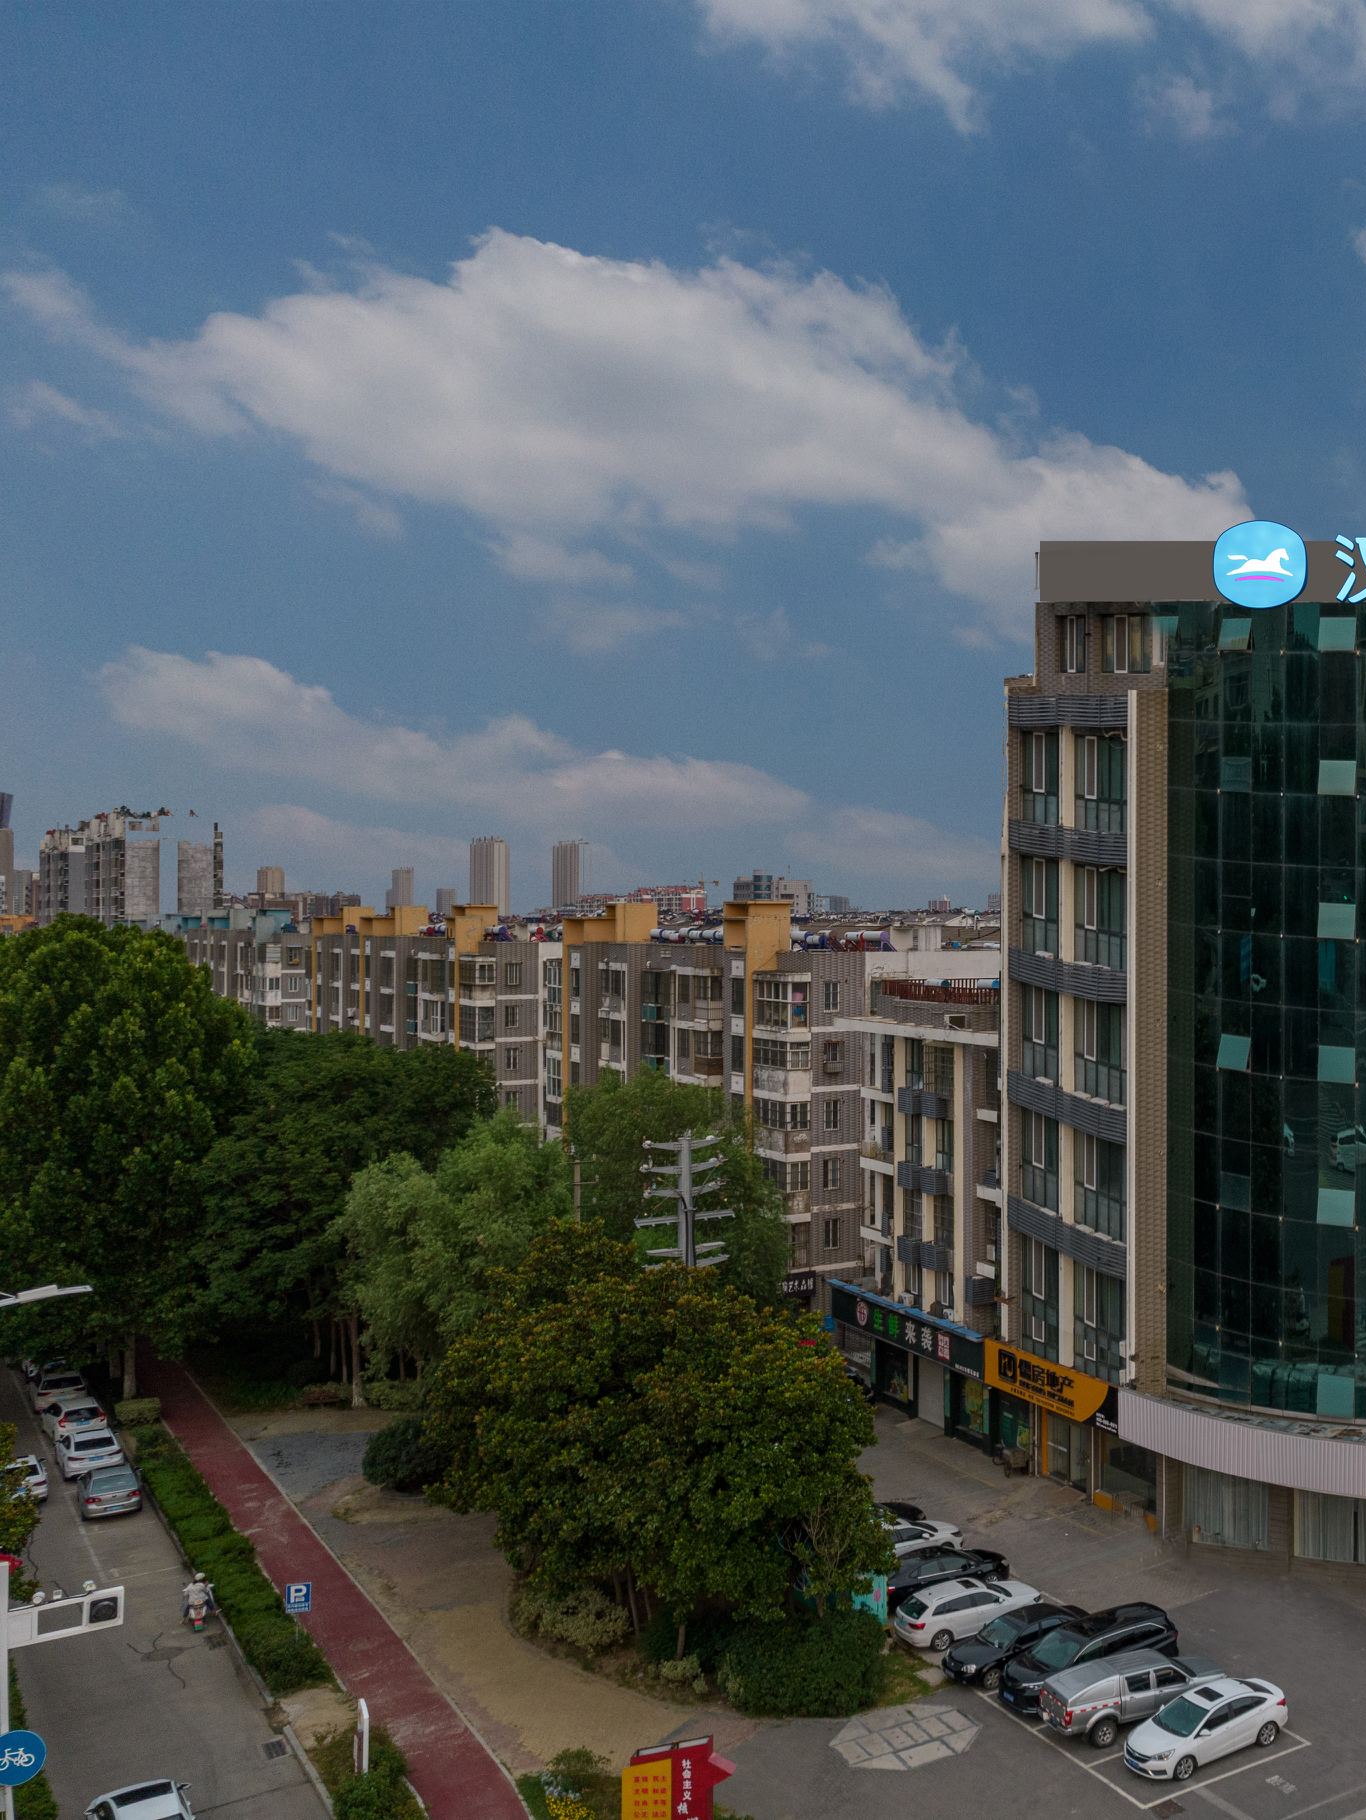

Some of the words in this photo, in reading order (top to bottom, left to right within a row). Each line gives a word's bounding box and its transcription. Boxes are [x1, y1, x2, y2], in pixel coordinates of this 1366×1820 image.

[873, 1308, 934, 1352] 生鲜来袭
[290, 1585, 307, 1604] P
[677, 1758, 698, 1820] 社会主义核
